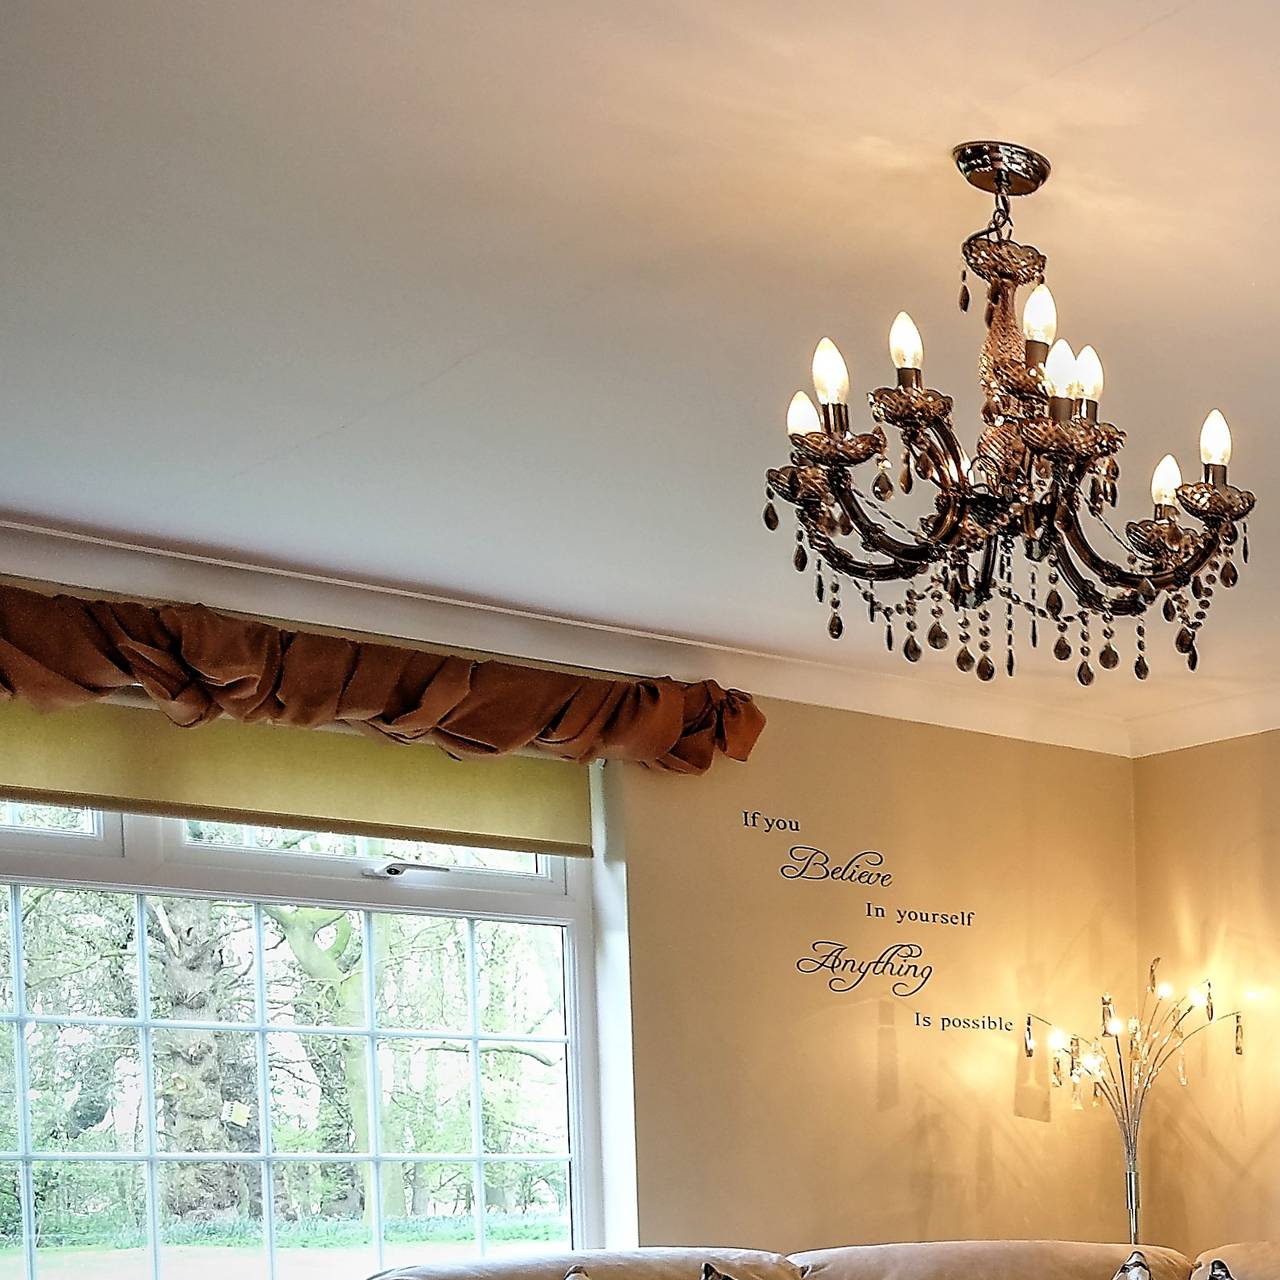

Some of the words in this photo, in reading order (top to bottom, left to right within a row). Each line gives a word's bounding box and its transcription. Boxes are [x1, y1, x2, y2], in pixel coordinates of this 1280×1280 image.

[742, 811, 761, 827] If
[764, 816, 800, 833] you
[780, 845, 894, 888] Believe
[866, 902, 885, 918] In
[896, 909, 975, 926] yourself
[796, 940, 934, 998] Anything
[914, 1012, 932, 1027] Is
[941, 1015, 1014, 1032] possible
